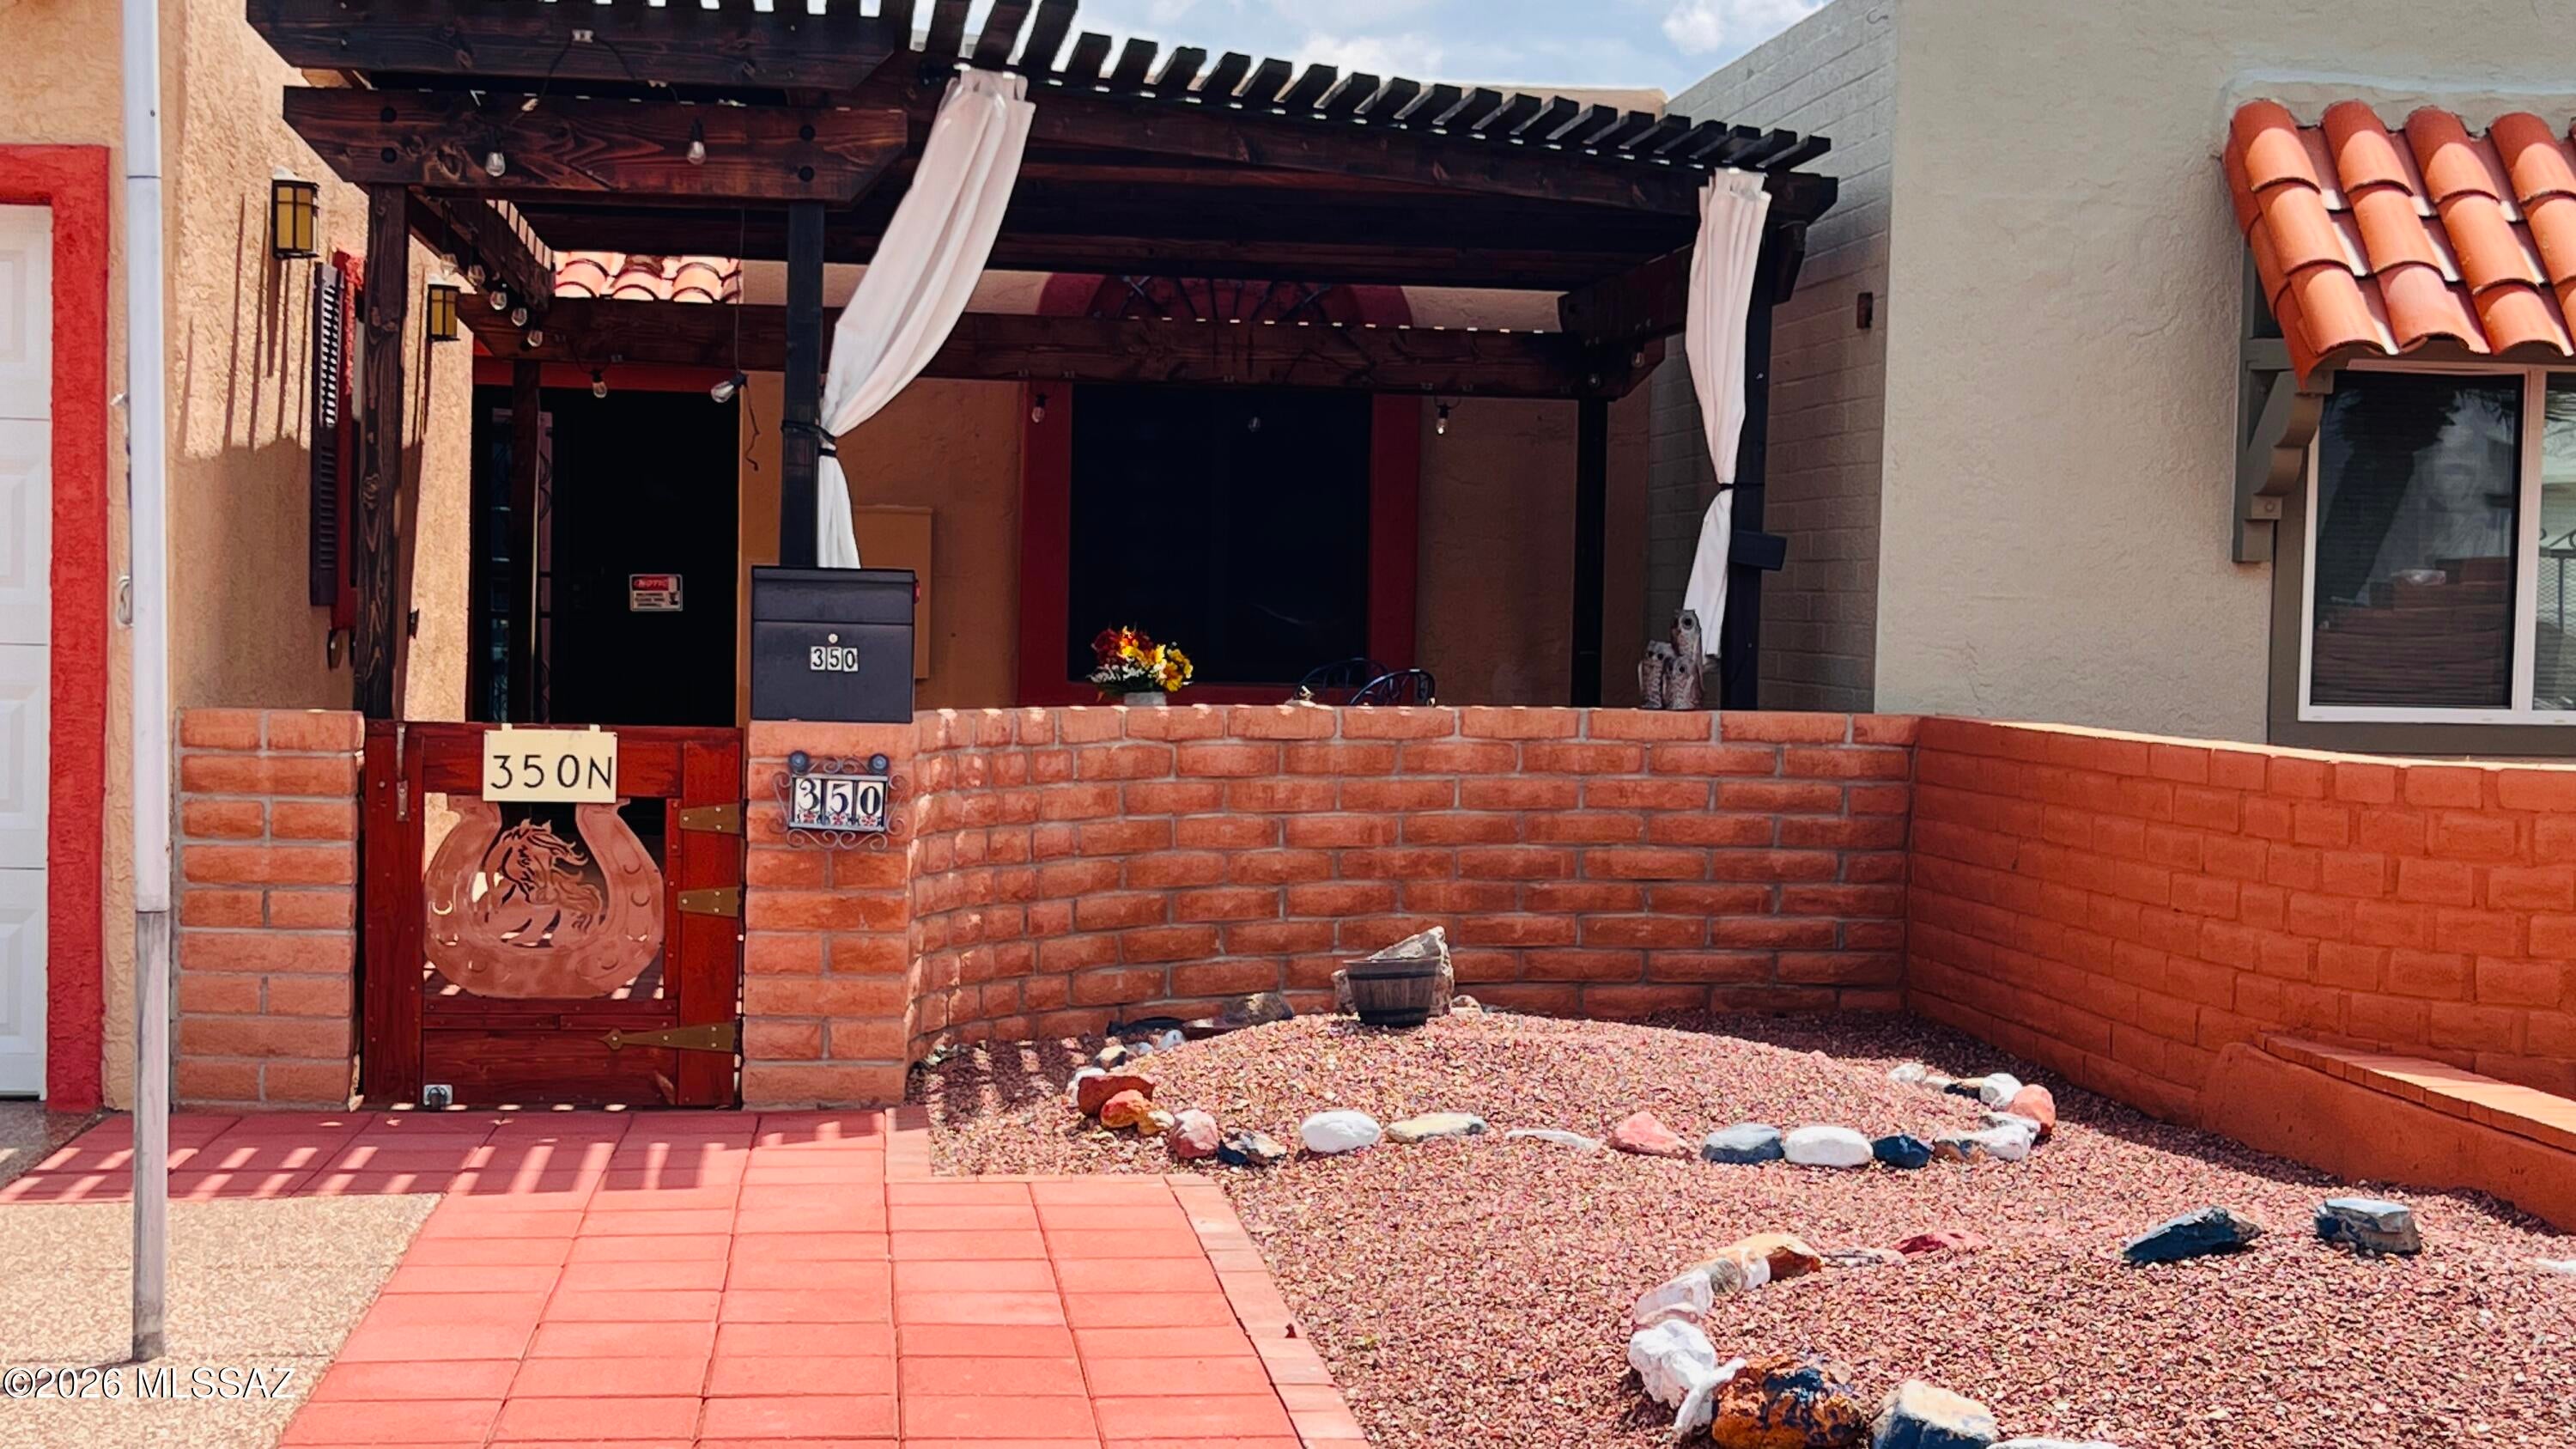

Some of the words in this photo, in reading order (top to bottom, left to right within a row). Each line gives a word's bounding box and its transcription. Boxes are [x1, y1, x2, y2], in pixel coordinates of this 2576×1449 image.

[811, 648, 856, 669] 350
[490, 754, 612, 789] 350N
[798, 777, 881, 816] 350
